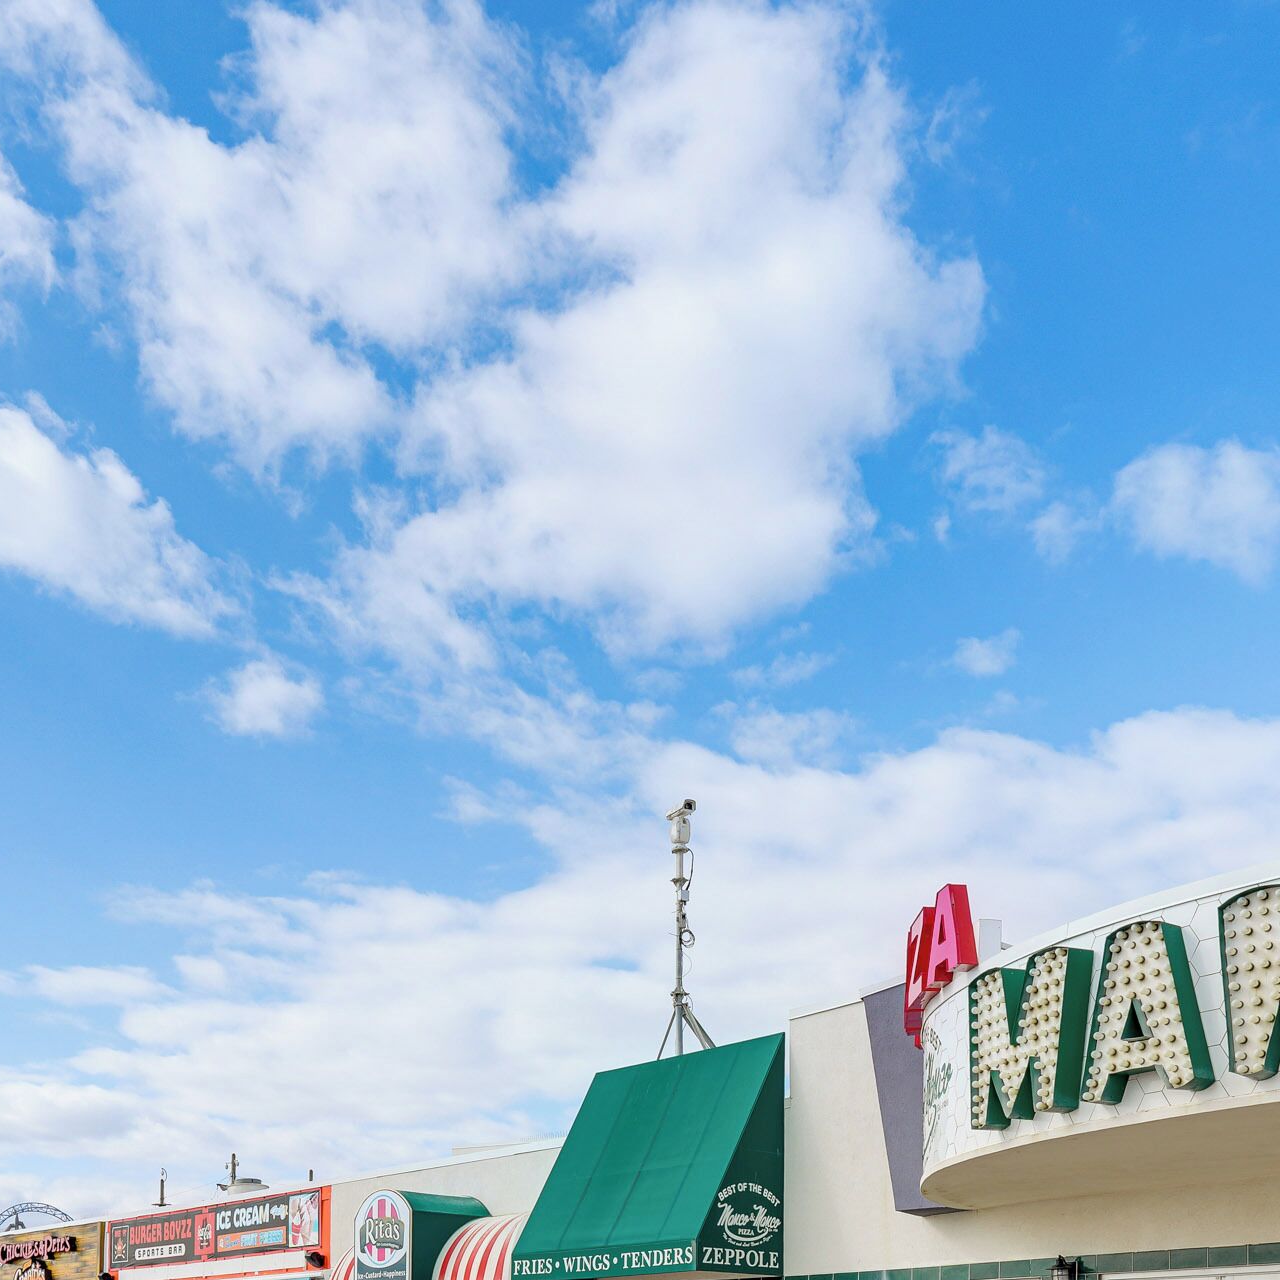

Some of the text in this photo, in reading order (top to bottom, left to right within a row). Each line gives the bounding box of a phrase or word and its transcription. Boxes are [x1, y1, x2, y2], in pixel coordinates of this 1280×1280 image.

[717, 1183, 781, 1207] BEST OF THE BEST
[216, 1209, 232, 1231] ICE
[233, 1203, 270, 1229] CREAM
[717, 1202, 750, 1227] Manco
[753, 1204, 782, 1230] Manco
[129, 1223, 162, 1246] BURGER
[163, 1219, 192, 1241] BOYZZ
[366, 1218, 400, 1245] Rita's
[738, 1228, 755, 1236] PIZZA
[137, 1245, 183, 1258] SPORTS BAR
[513, 1246, 693, 1276] FRIES WINGS TENDERS
[702, 1246, 779, 1269] ZEPPOLE
